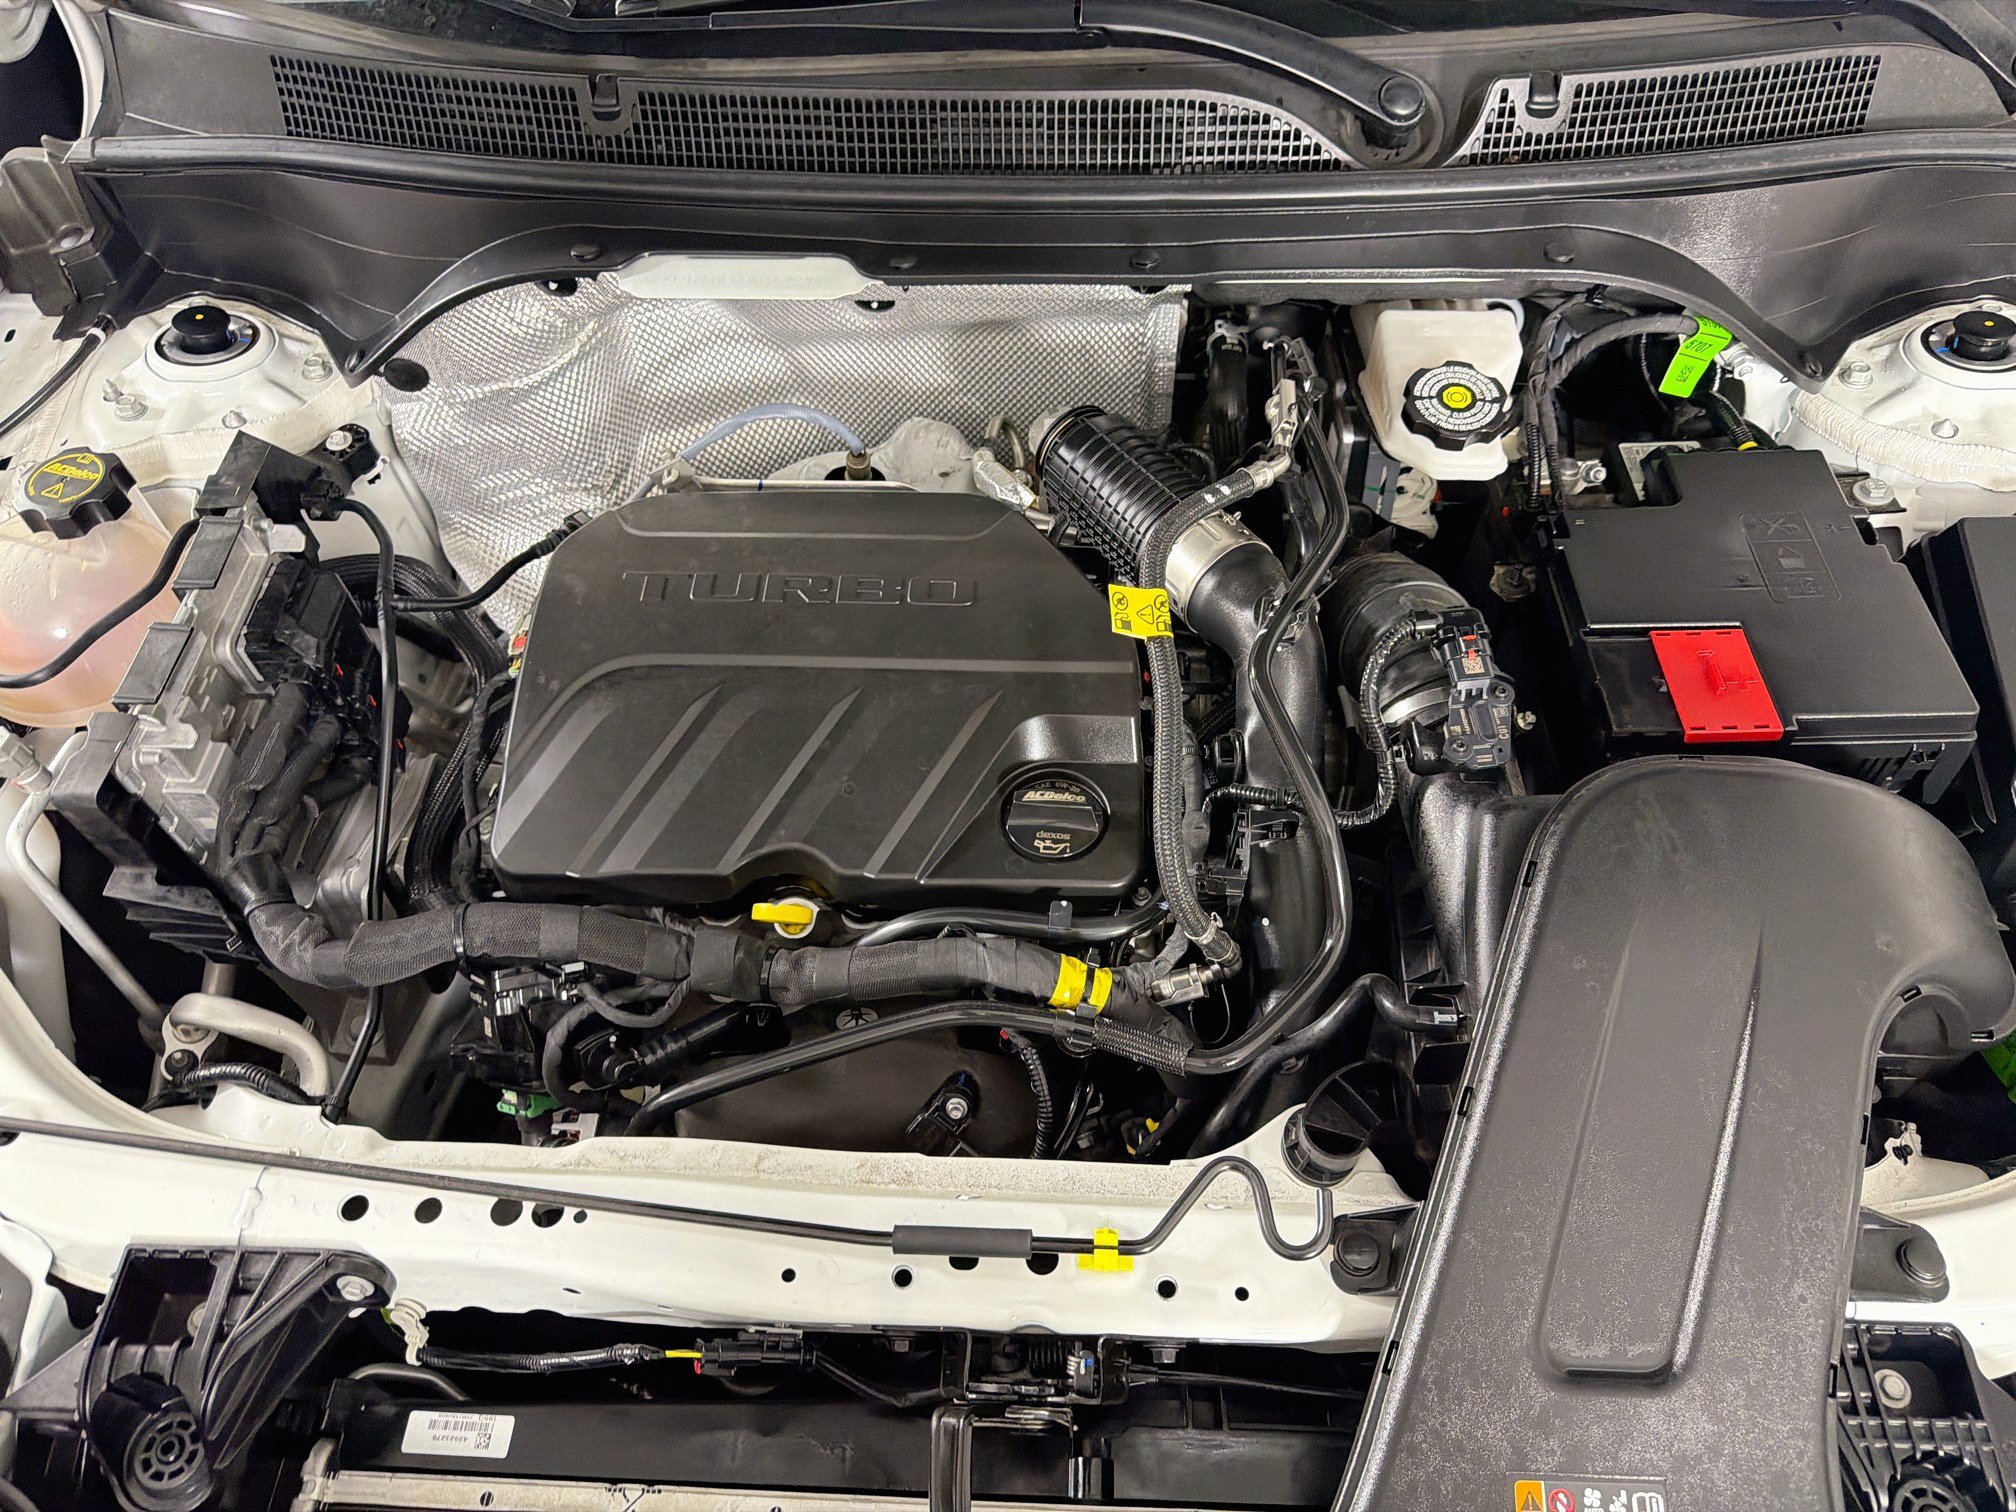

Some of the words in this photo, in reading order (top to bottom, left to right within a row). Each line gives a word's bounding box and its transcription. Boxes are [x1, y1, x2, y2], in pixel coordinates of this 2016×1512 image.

[43, 463, 100, 481] ACDelco
[622, 571, 979, 607] TURBO
[1022, 790, 1087, 803] ACDelco
[1036, 830, 1072, 840] dexos
